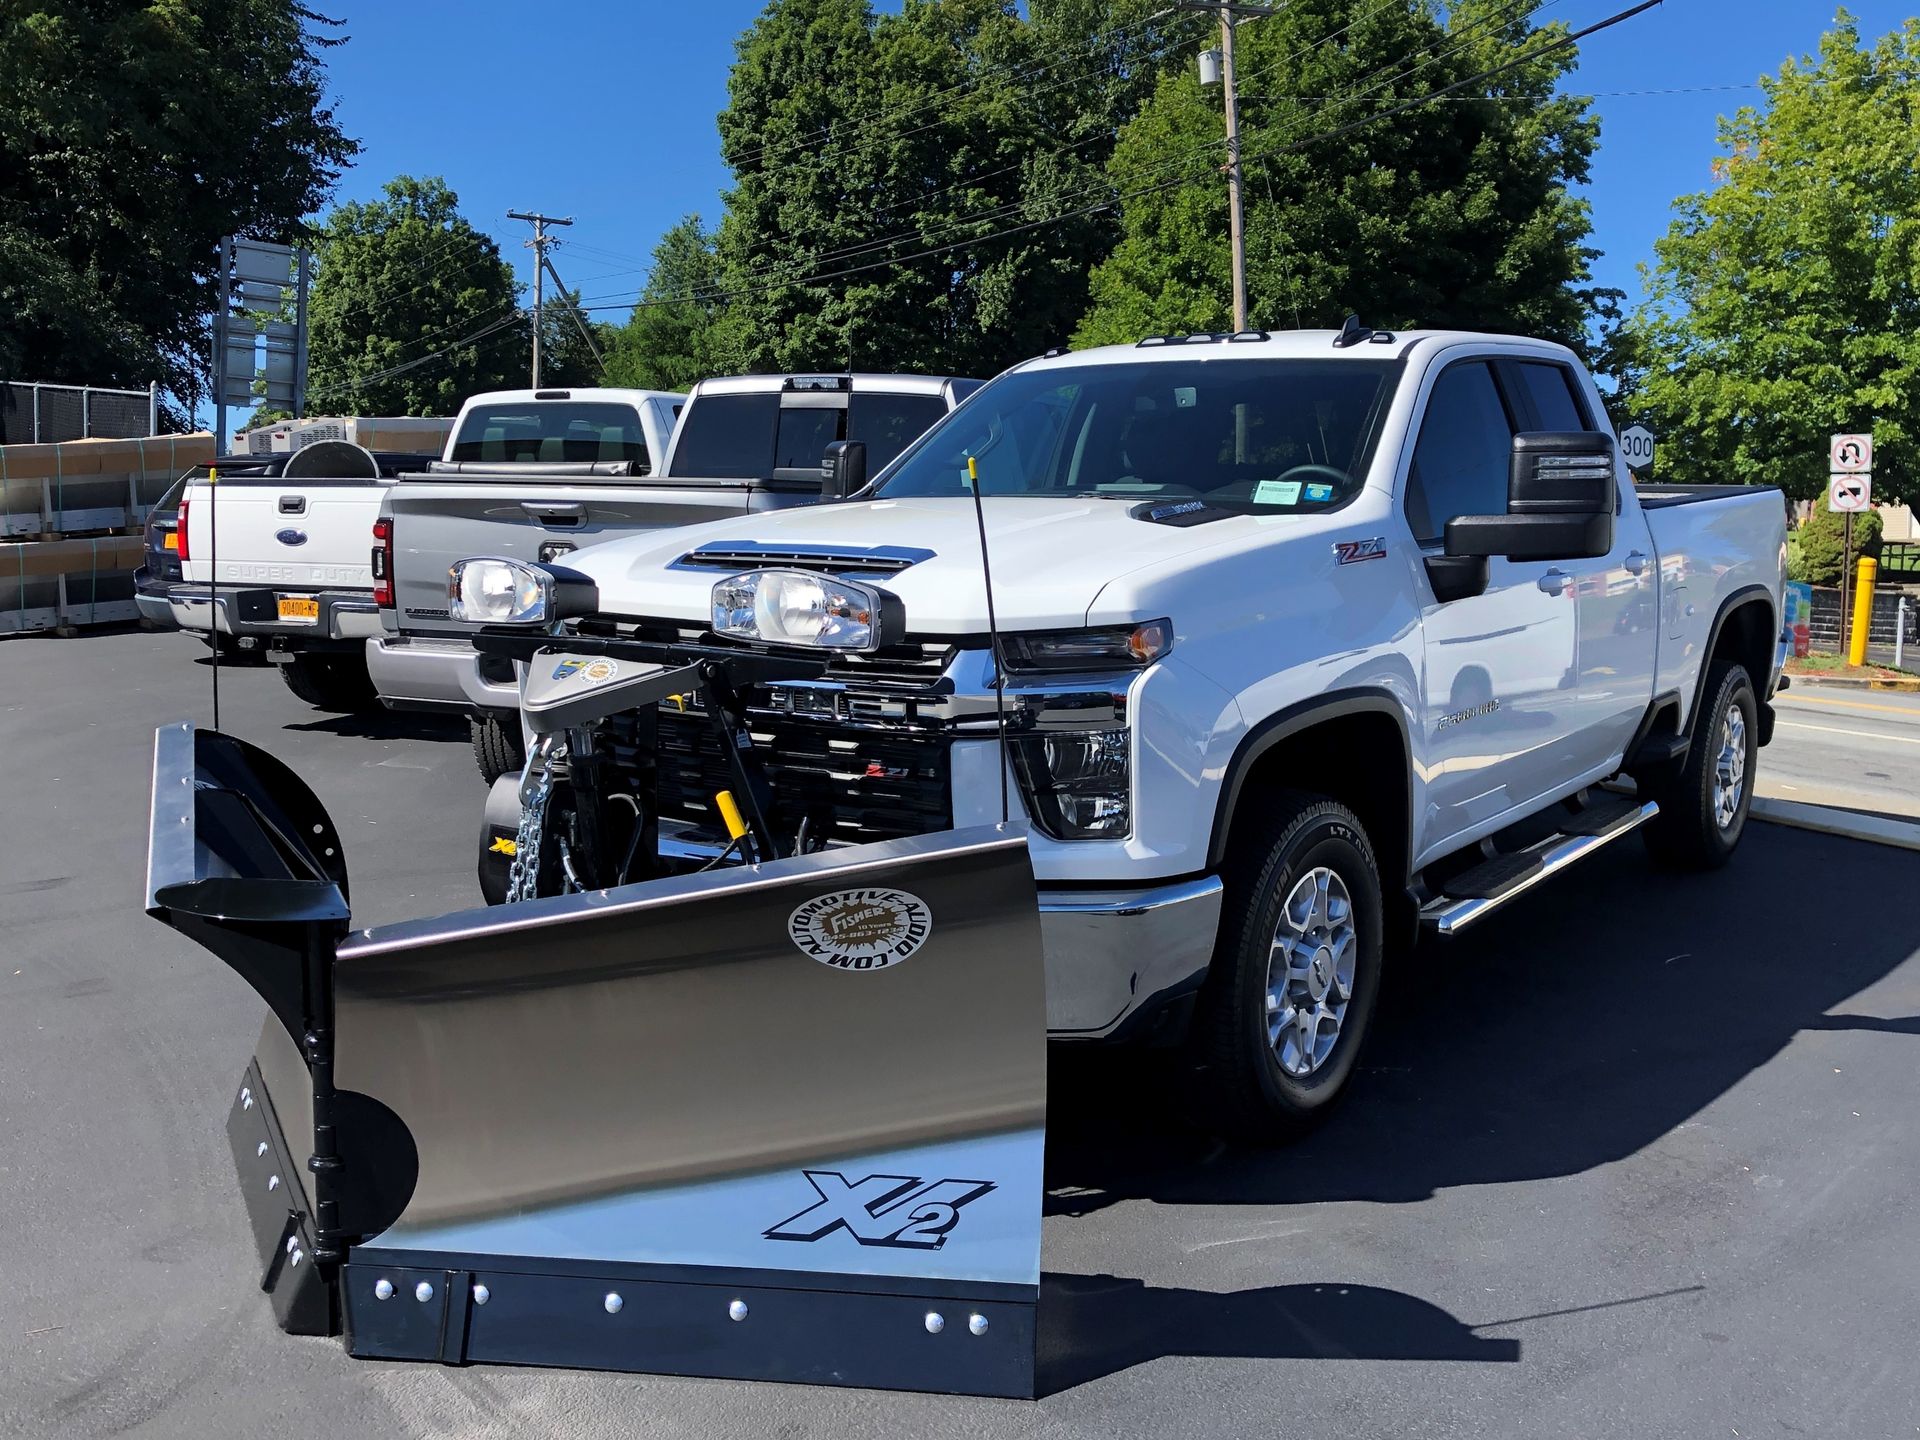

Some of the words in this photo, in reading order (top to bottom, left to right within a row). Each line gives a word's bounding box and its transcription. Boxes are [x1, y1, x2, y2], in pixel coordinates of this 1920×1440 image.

[1623, 435, 1652, 458] 300
[226, 565, 296, 581] SUPER
[309, 567, 367, 583] DUTY
[1330, 826, 1352, 840] LTX
[830, 906, 886, 935] FISHER
[869, 921, 892, 929] Years
